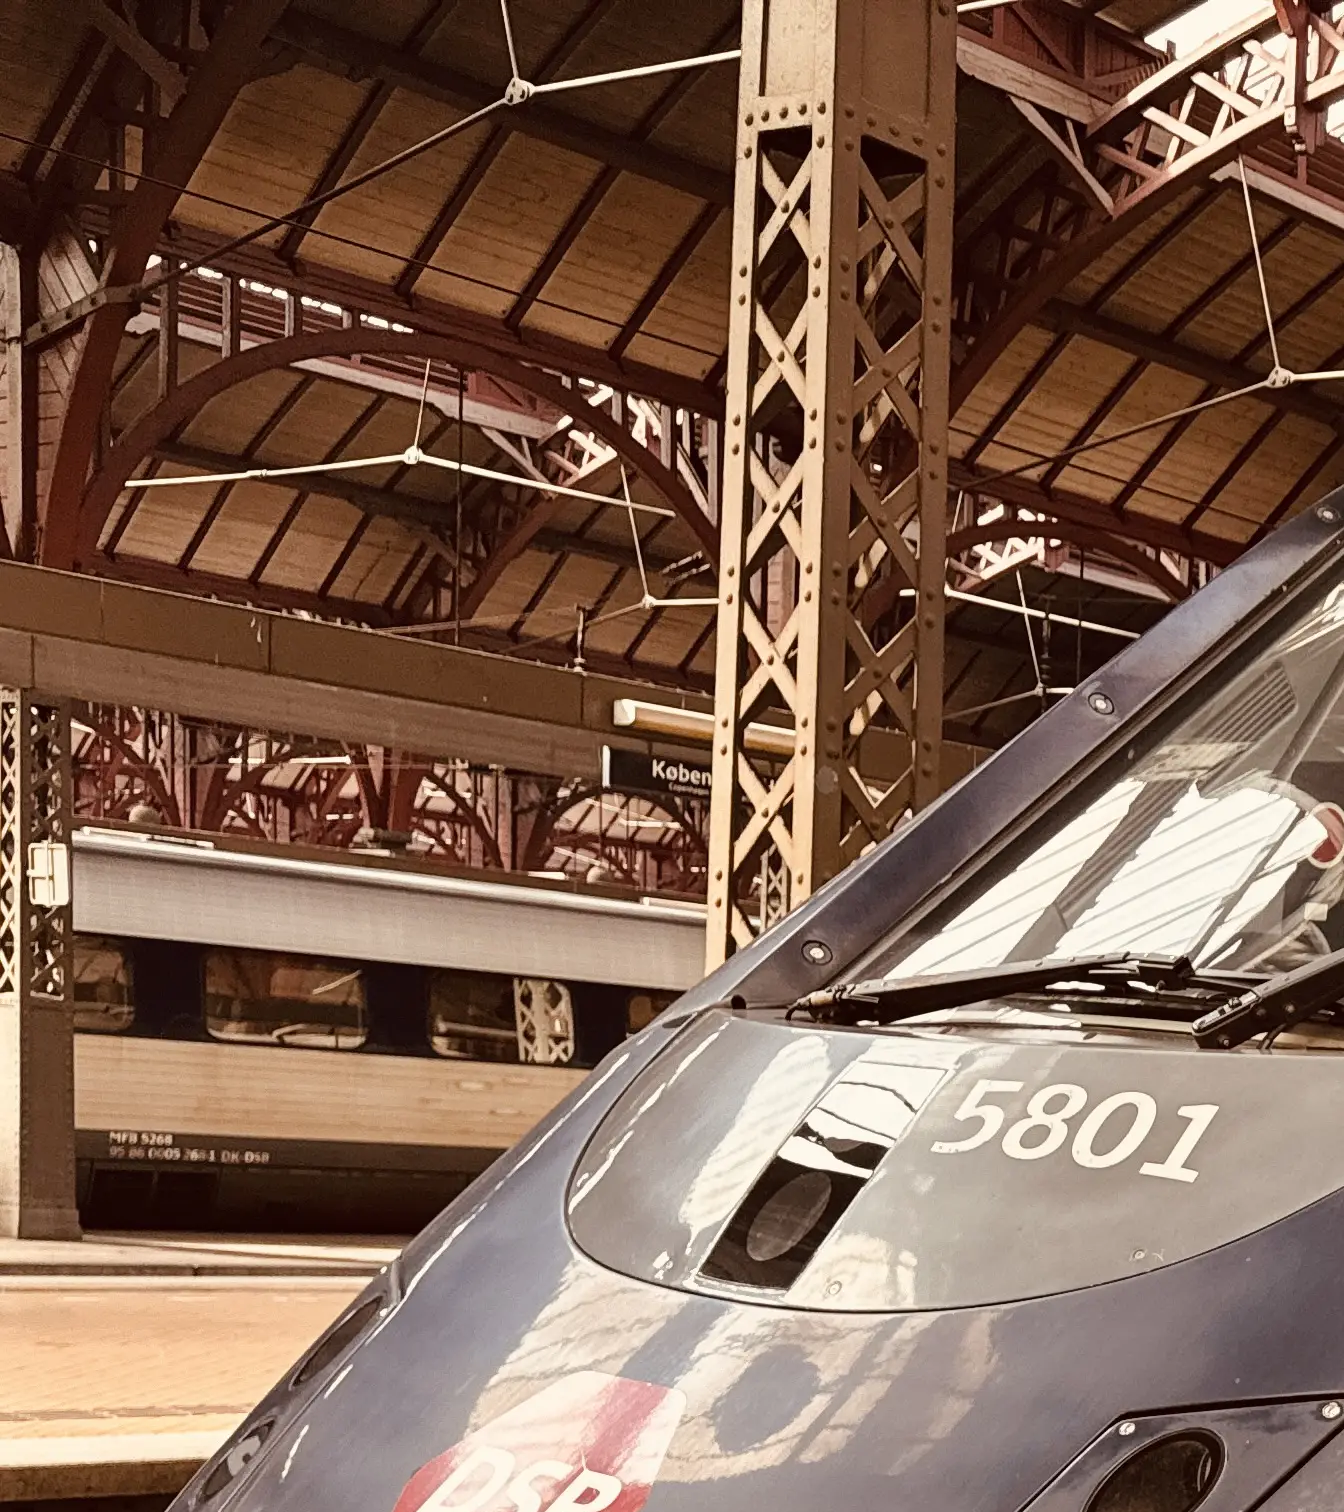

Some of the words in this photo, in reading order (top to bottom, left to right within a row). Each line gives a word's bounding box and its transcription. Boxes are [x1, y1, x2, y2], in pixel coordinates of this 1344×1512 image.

[652, 759, 712, 786] Køben
[141, 1132, 173, 1146] 5268
[930, 1079, 1220, 1184] 5801
